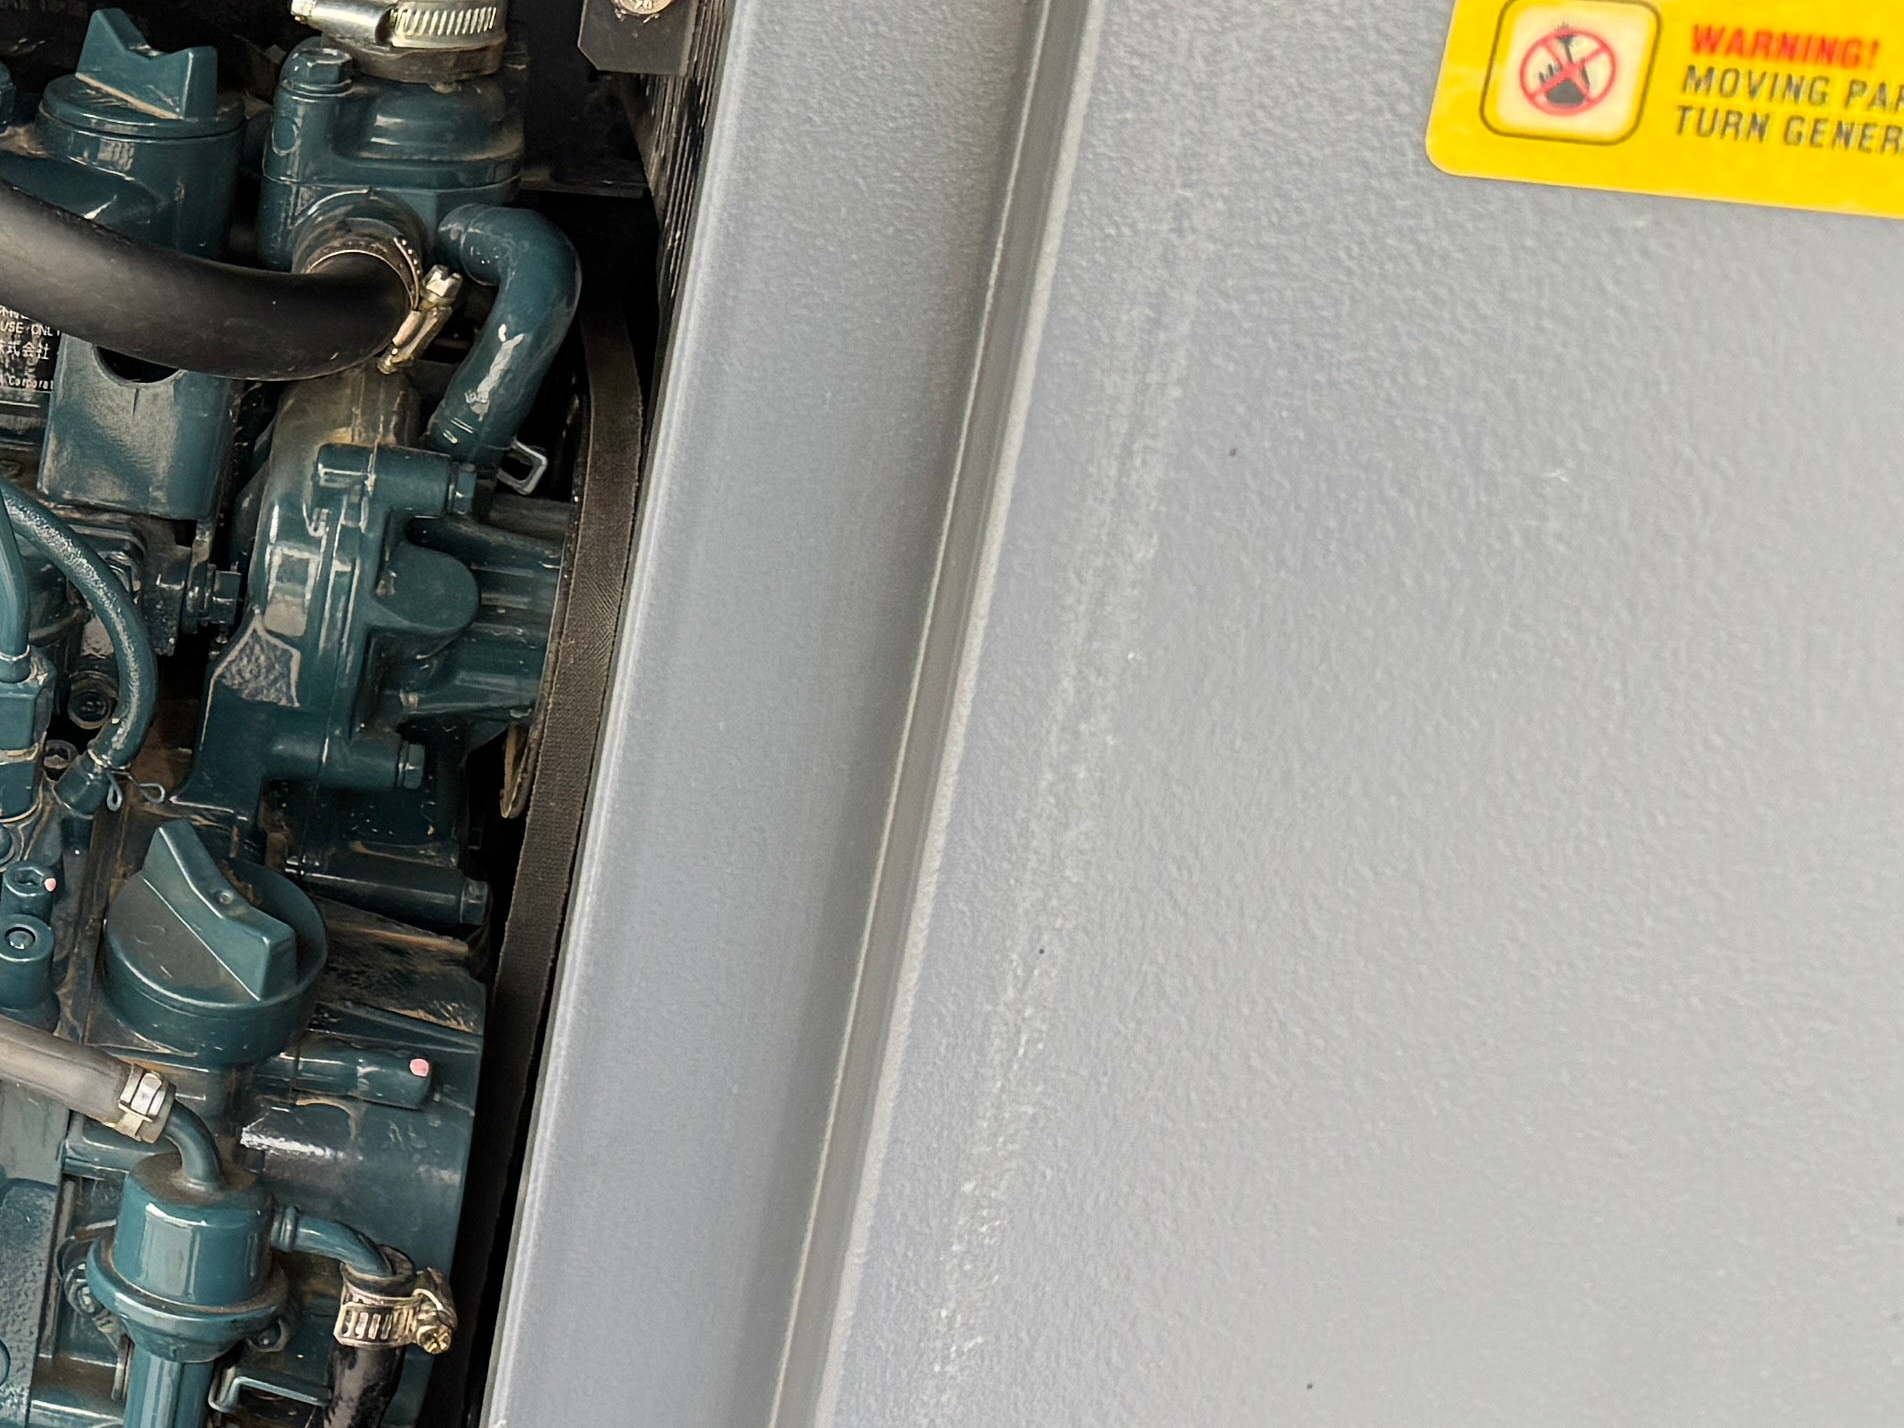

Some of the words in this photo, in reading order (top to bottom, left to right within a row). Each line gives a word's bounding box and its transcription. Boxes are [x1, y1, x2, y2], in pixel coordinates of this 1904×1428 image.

[1692, 25, 1881, 70] WARNING!
[1681, 65, 1830, 106] MOVING
[1676, 105, 1770, 143] TURN
[0, 320, 24, 334] USE
